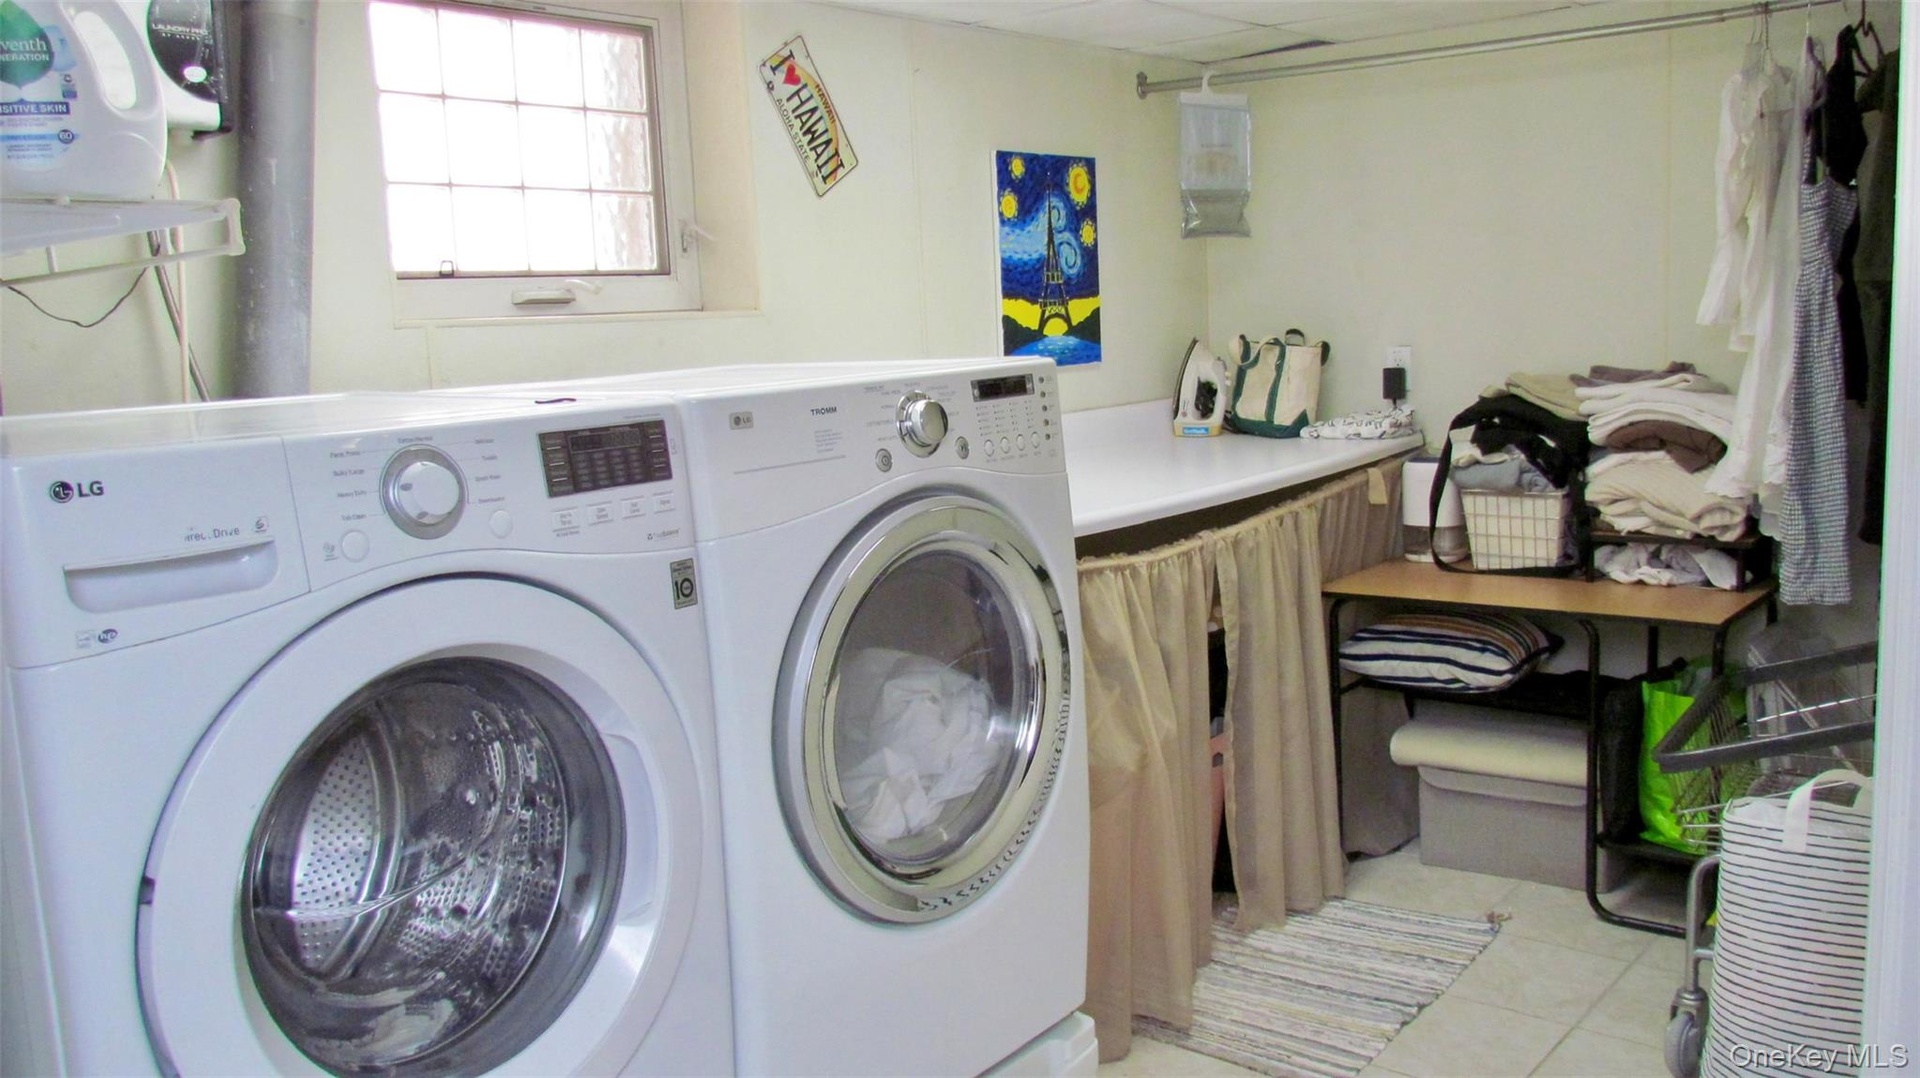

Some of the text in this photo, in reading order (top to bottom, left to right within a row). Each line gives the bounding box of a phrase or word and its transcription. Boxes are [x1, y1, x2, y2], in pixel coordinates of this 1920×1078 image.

[0, 38, 47, 52] venth
[0, 103, 67, 114] SITIVE SKIN
[815, 84, 837, 124] HAWAII
[770, 49, 846, 185] I HAWAII
[60, 131, 73, 140] 60
[776, 98, 812, 163] ALOHA STATE
[810, 406, 838, 416] TROMM
[77, 480, 105, 499] LG
[674, 577, 694, 601] 10
